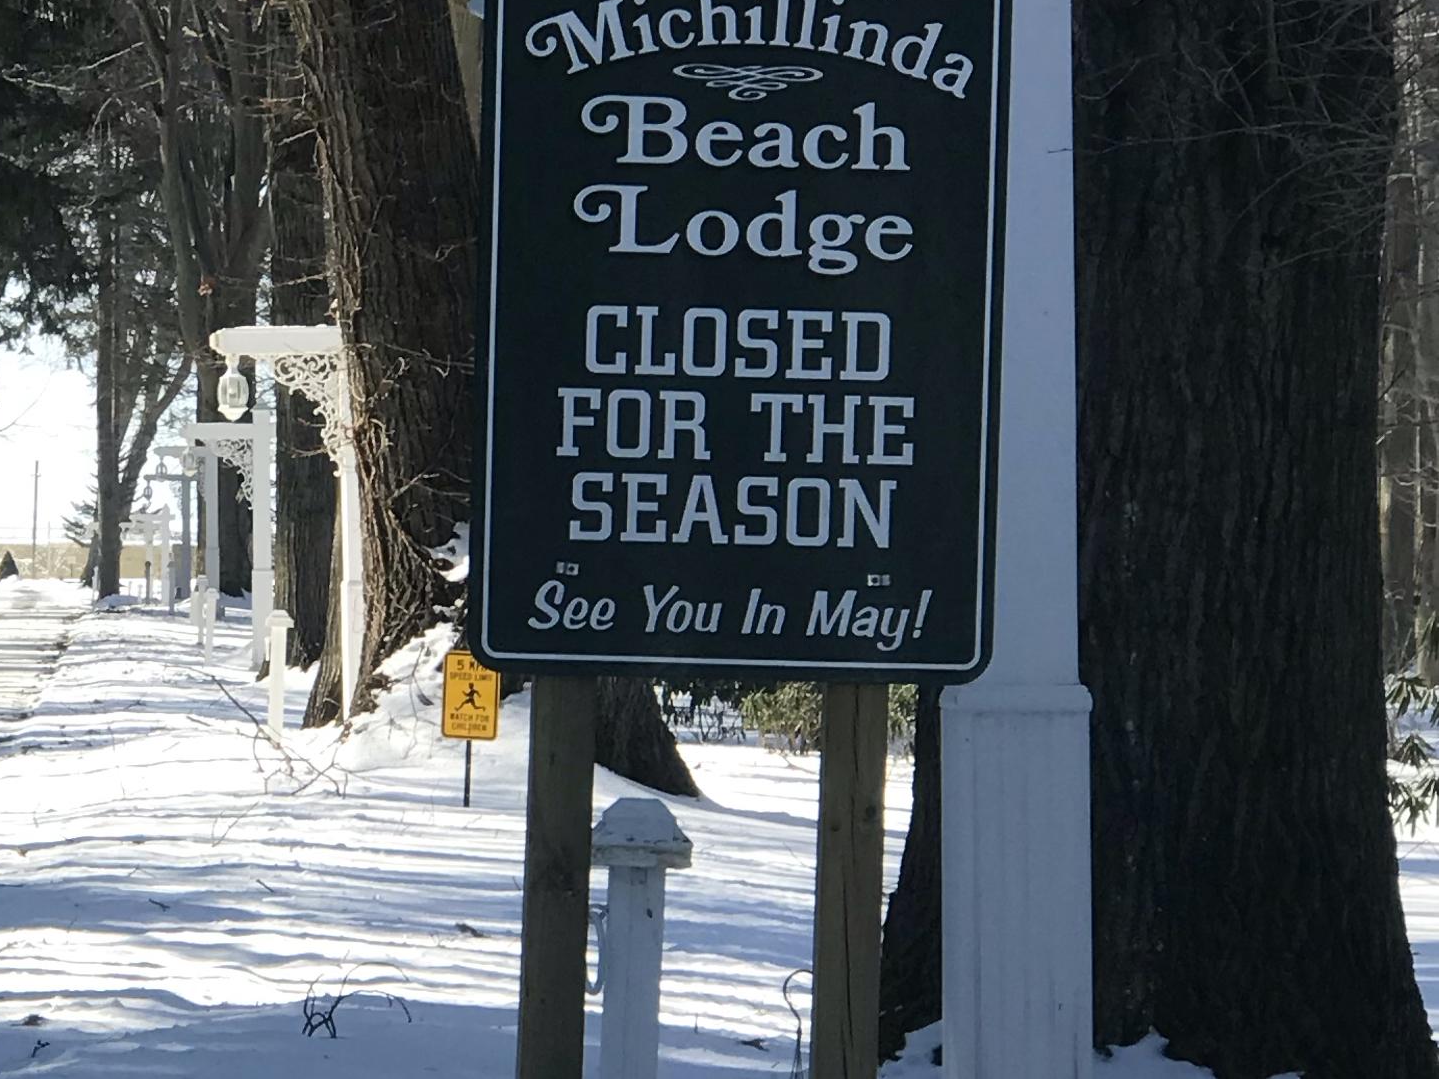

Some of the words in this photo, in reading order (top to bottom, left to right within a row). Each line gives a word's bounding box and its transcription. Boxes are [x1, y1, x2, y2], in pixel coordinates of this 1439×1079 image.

[580, 94, 911, 171] Beach
[573, 184, 913, 275] Lodge
[585, 305, 891, 381] CLOSED
[556, 387, 711, 460] FOR
[750, 392, 915, 466] THE
[569, 471, 898, 549] SEASON
[527, 579, 616, 631] See
[642, 584, 723, 633] You
[740, 588, 786, 635] In
[805, 589, 933, 652] May!
[449, 672, 473, 681] SPEED
[456, 659, 465, 671] 5
[449, 713, 474, 721] WATCH
[475, 714, 490, 723] FOR
